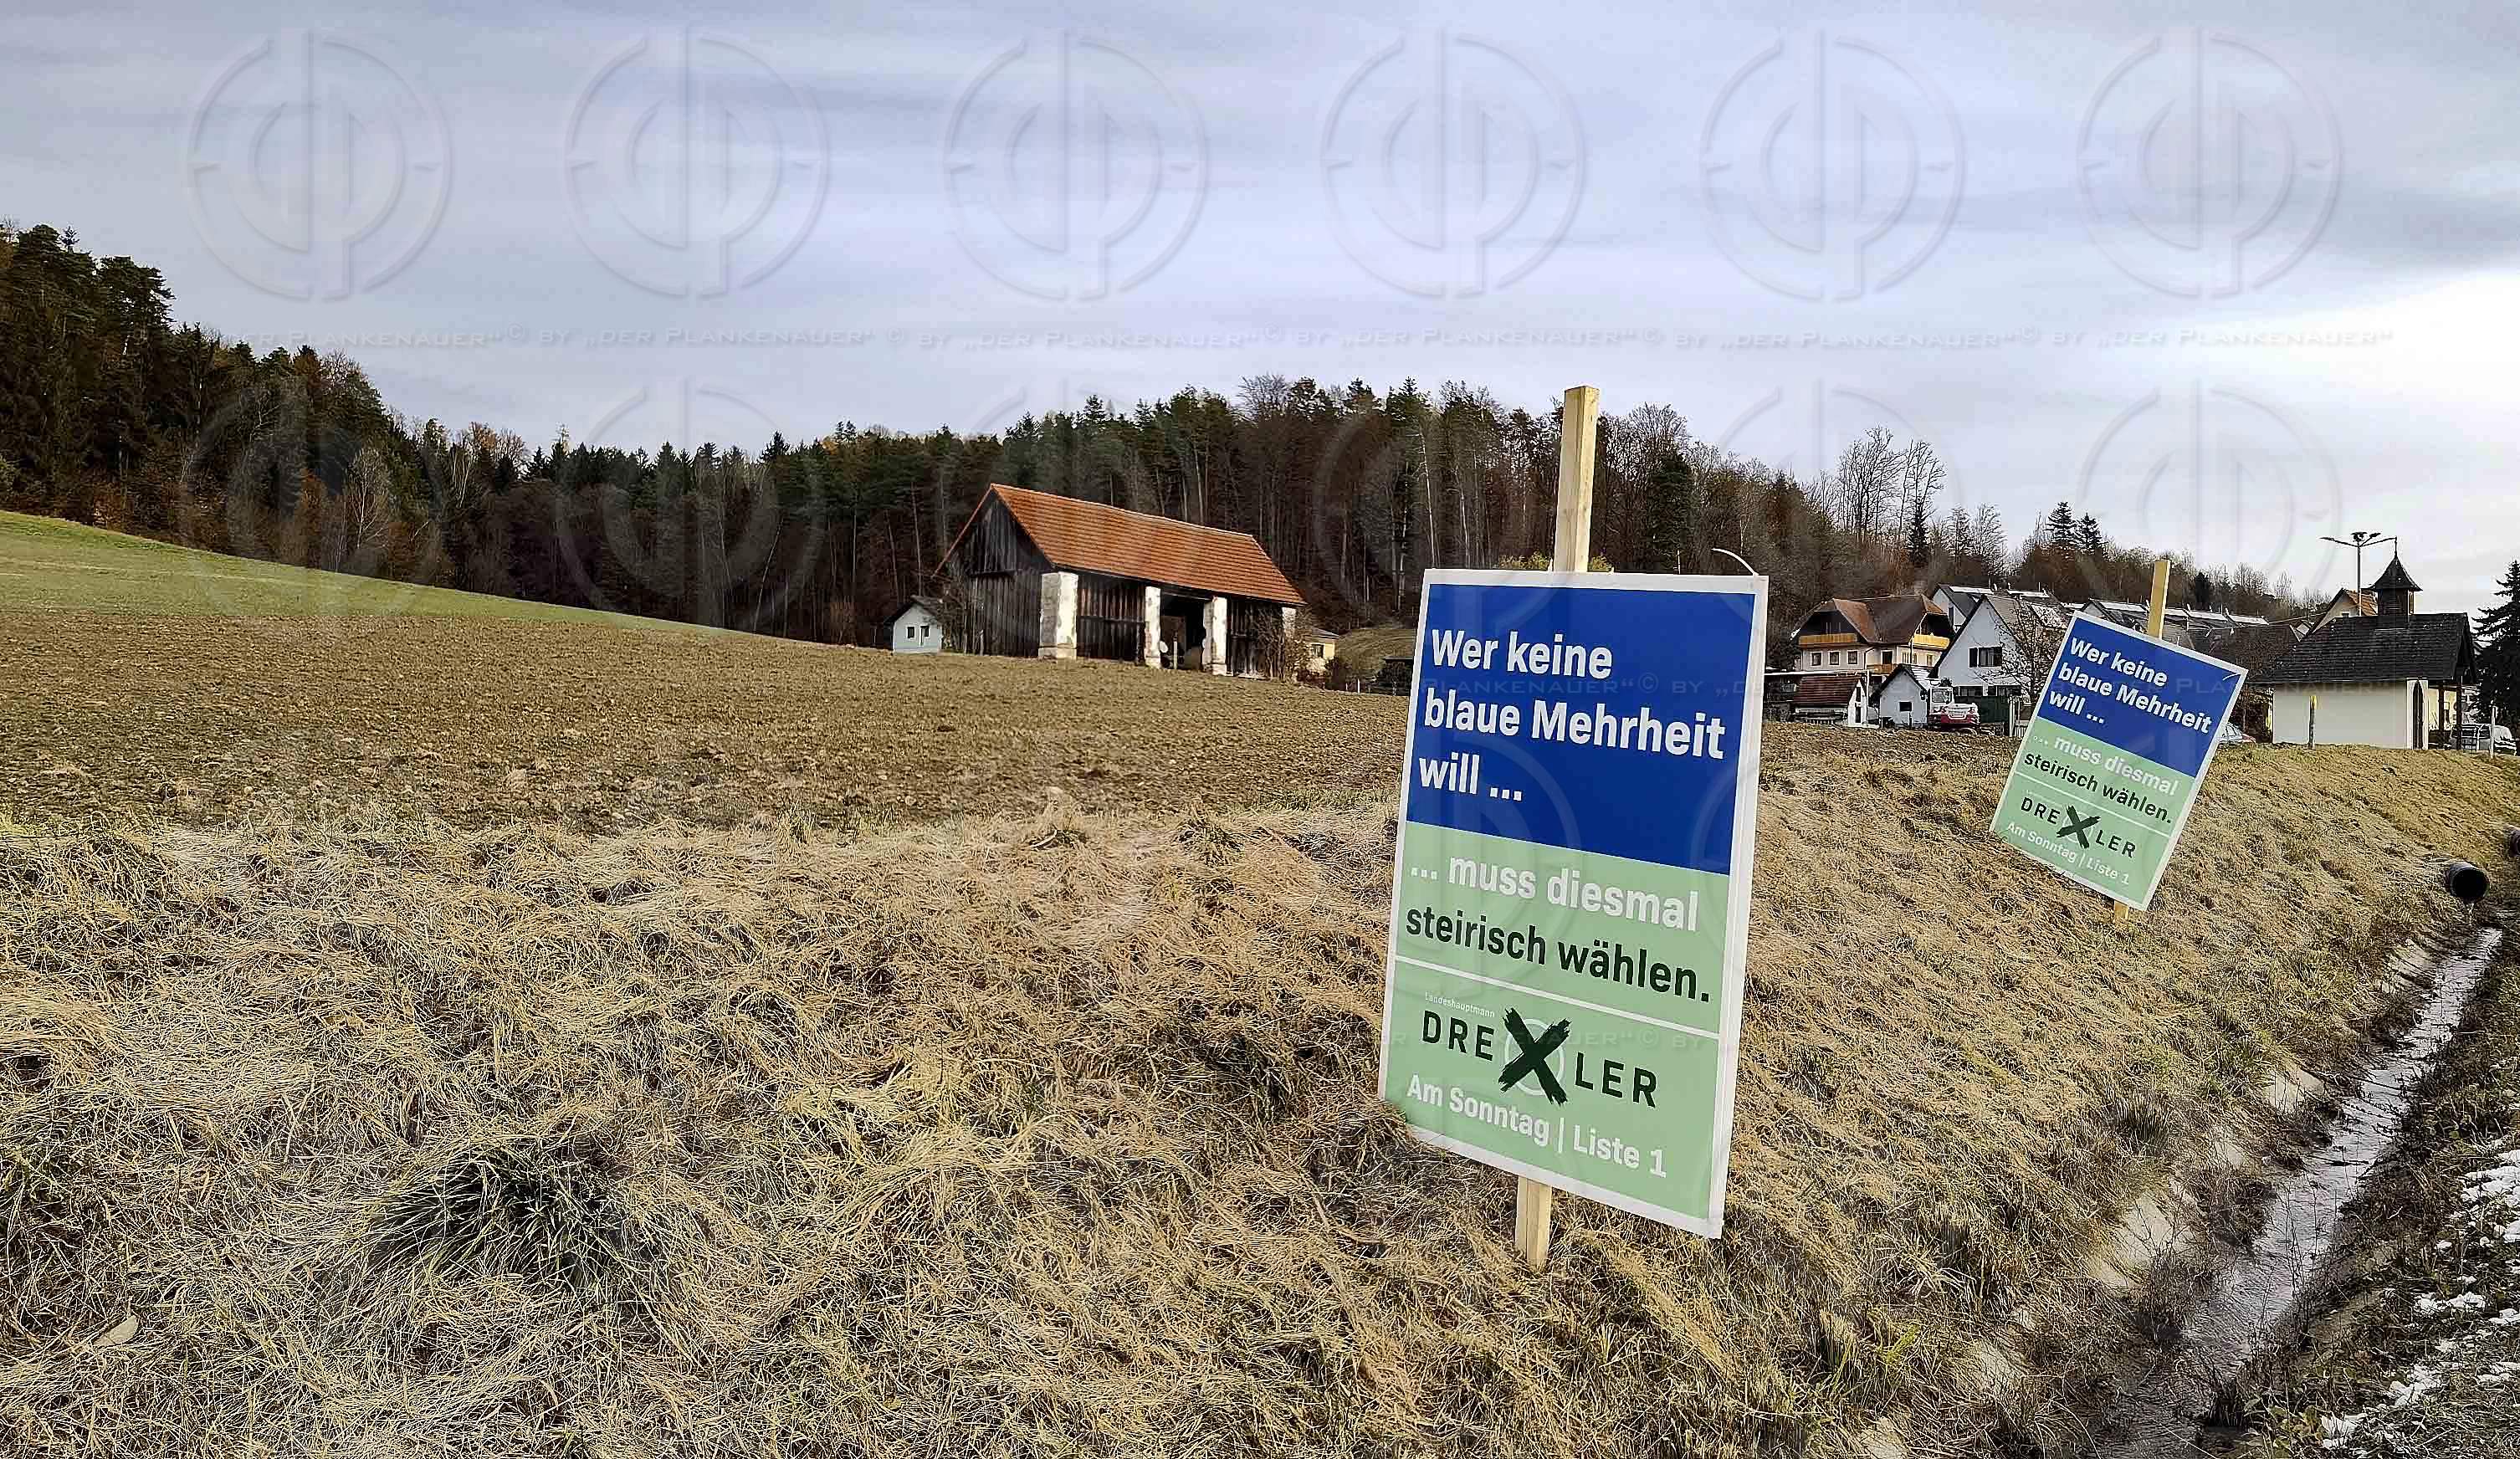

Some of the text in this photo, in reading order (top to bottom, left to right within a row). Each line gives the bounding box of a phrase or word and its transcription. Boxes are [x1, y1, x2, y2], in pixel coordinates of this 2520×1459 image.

[1432, 629, 1613, 679] Wer keine
[2071, 637, 2168, 688] Wer keine
[1424, 688, 1726, 760] blaue Mehrheit
[2049, 691, 2086, 716] will
[2058, 663, 2113, 697] blaue
[2115, 684, 2213, 735] Mehrheit
[1418, 751, 1480, 795] will
[2024, 753, 2098, 793] steirisch
[2103, 784, 2172, 824] wählen.
[2054, 735, 2102, 765] muss
[2104, 755, 2179, 796] diesmal
[2007, 821, 2026, 839] Am
[2027, 829, 2078, 864] Sonntag
[2087, 857, 2119, 880] Liste
[2121, 872, 2129, 885] 1
[1448, 857, 1537, 899] muss
[1547, 868, 1699, 932] diesmal
[1406, 907, 1710, 1003] steirisch wählen.
[1421, 1007, 1657, 1108] DREXLER
[1406, 1074, 1442, 1107] Am
[1449, 1088, 1550, 1149] Sonntag
[1573, 1124, 1640, 1170] Liste
[1648, 1149, 1667, 1179] 1
